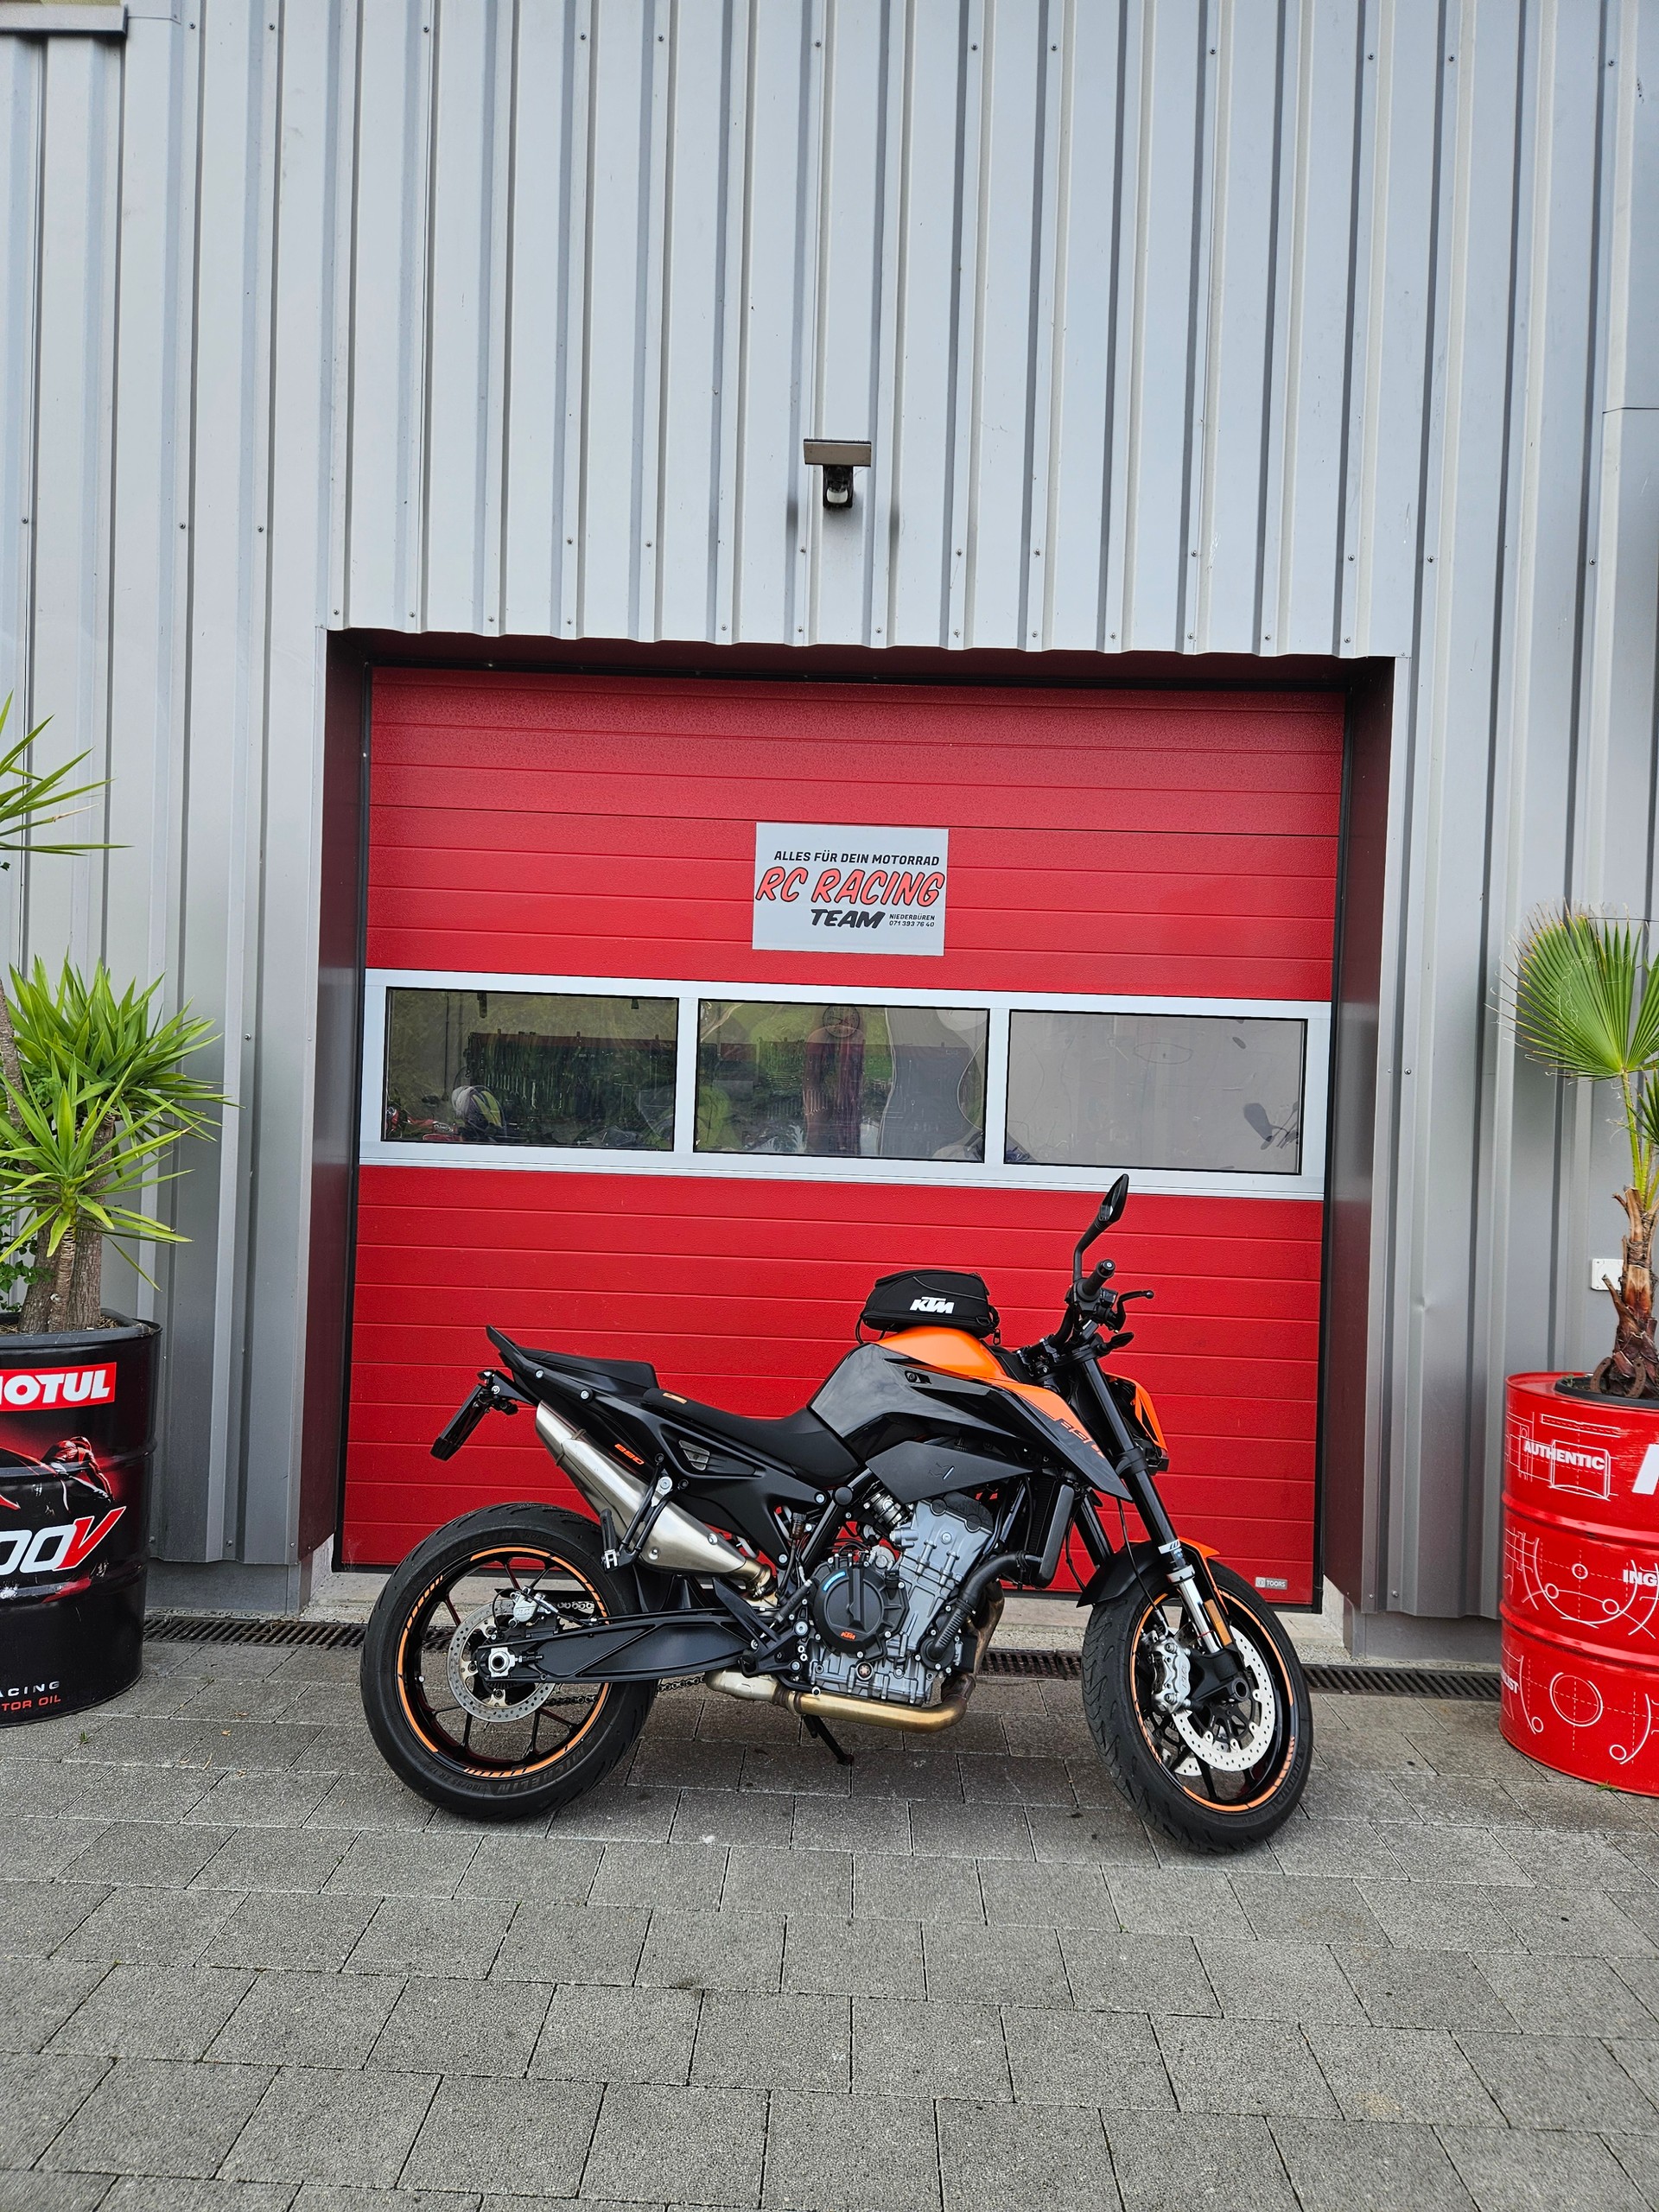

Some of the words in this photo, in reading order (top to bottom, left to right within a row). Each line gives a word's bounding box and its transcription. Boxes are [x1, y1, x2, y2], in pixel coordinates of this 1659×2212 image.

[773, 850, 811, 862] ALLES
[814, 849, 838, 863] FÜR
[840, 852, 869, 864] DEIN
[871, 854, 940, 866] MOTORRAD
[755, 866, 809, 902] RC
[810, 868, 945, 907] RACING
[810, 908, 886, 929] TEAM
[909, 1296, 955, 1314] KTM
[0, 1370, 111, 1405] OTUL
[1523, 1440, 1605, 1471] AUTHENTIC
[38, 1694, 61, 1707] OIL
[496, 1746, 585, 1795] MICHELIN
